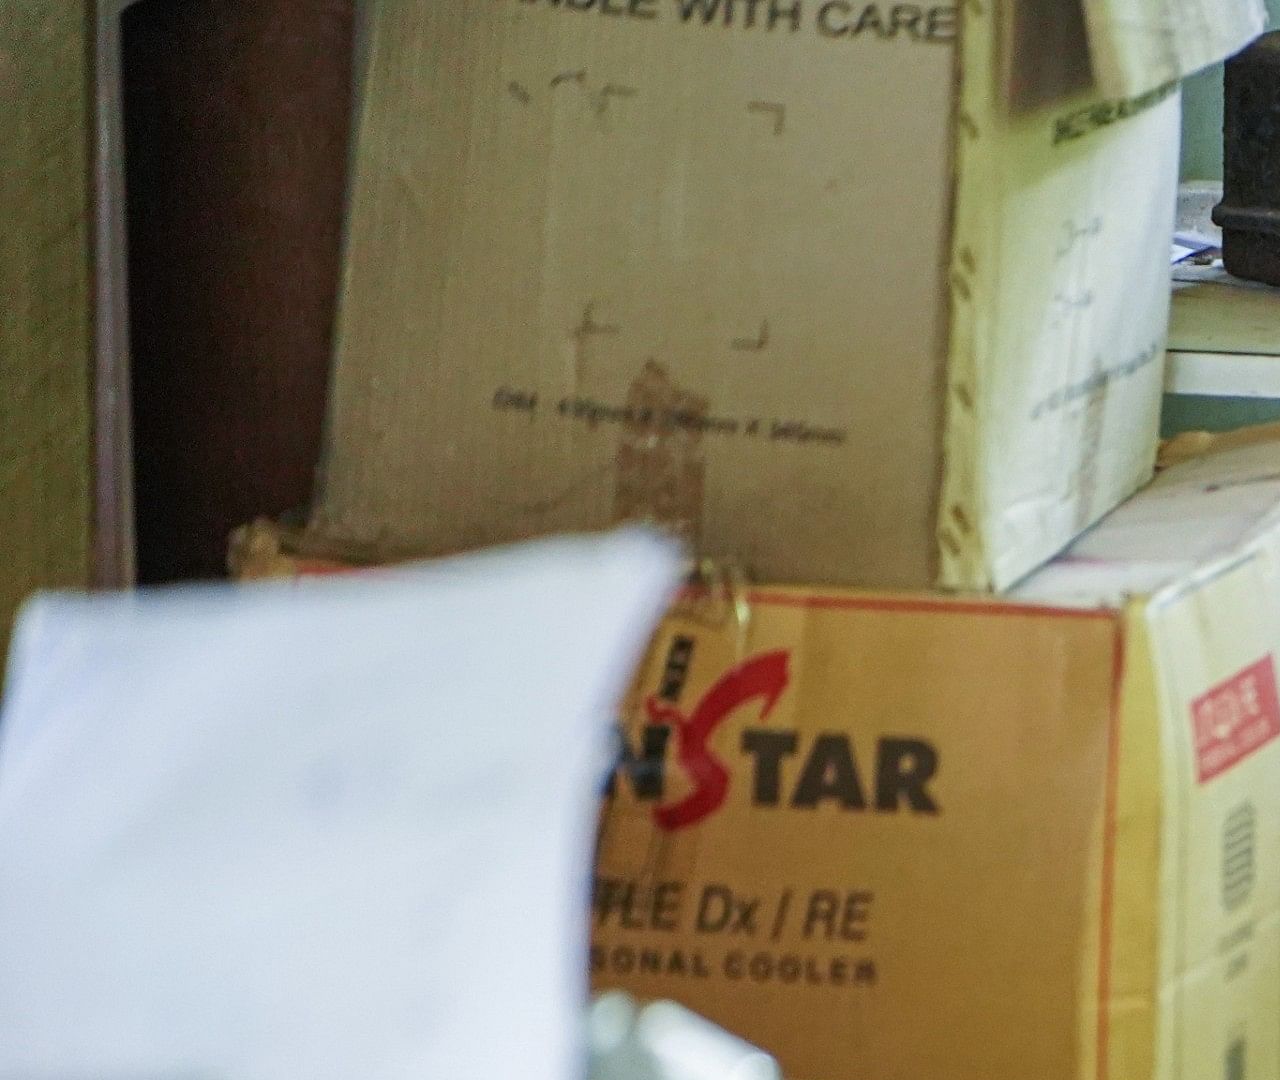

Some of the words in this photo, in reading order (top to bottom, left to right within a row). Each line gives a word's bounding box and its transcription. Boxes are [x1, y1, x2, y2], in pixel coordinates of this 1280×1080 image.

[677, 0, 801, 32] WITH
[815, 0, 957, 44] CARE
[802, 888, 876, 943] RE
[723, 946, 880, 987] COOLER
